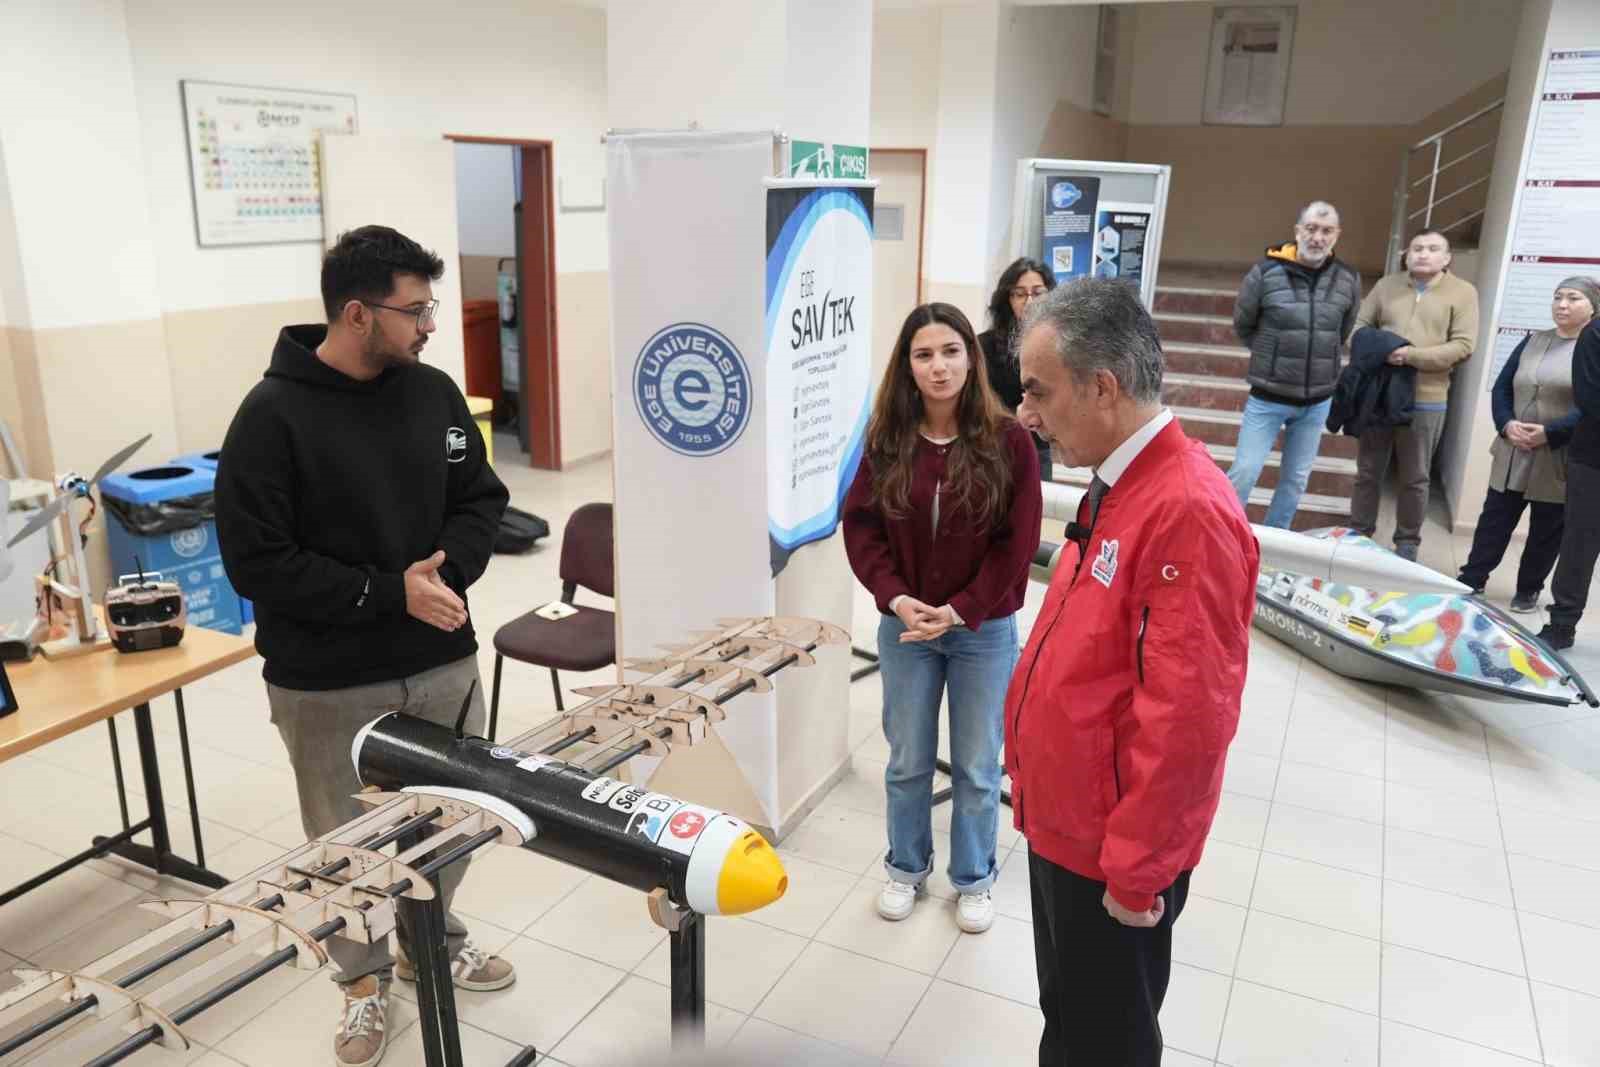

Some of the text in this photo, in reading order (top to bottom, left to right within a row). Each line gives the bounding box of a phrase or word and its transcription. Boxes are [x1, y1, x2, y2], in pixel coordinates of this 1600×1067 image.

[800, 269, 815, 298] EGE
[791, 288, 855, 350] SAVTEK
[643, 335, 741, 440] EGE ÜNİVERSİTESİ
[679, 431, 713, 444] 1955
